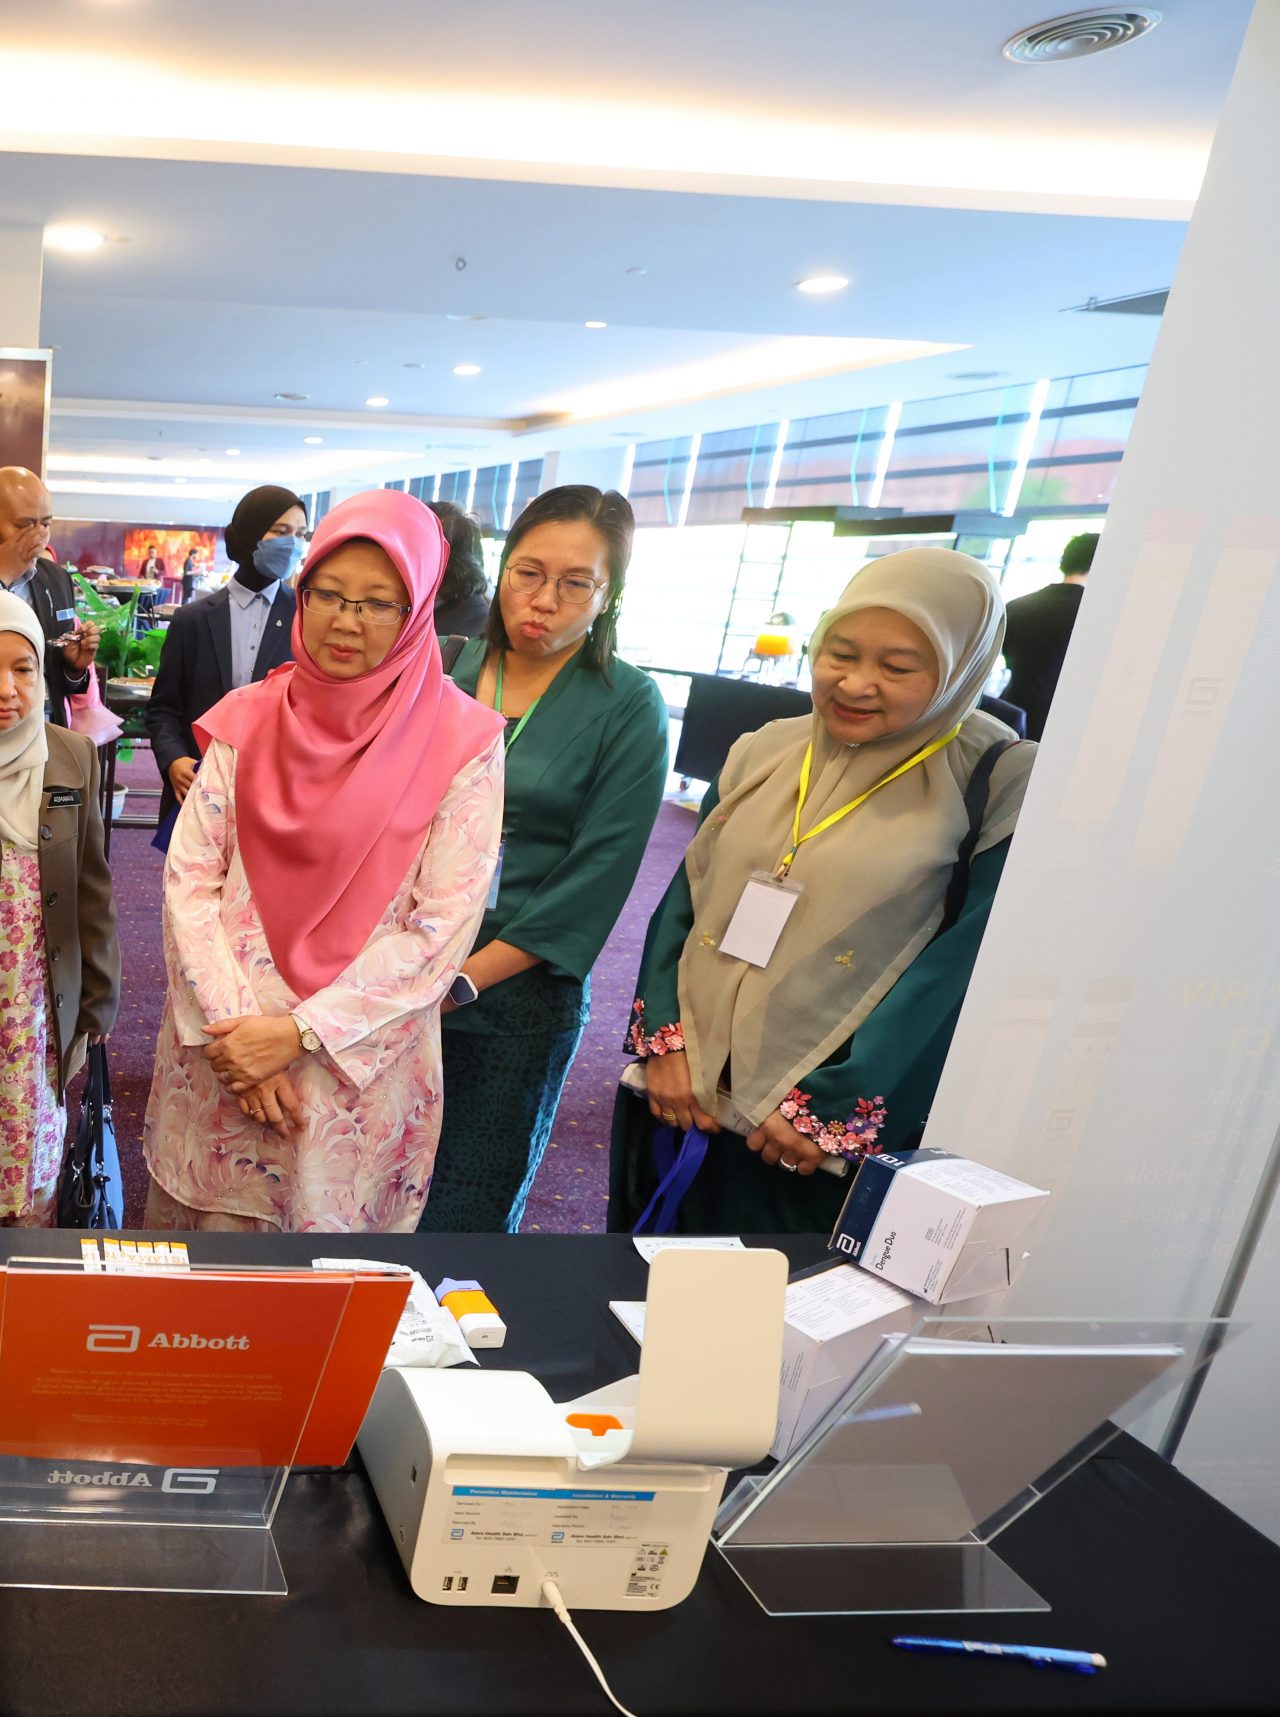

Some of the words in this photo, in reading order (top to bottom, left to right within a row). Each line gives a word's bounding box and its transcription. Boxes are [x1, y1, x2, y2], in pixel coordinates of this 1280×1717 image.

[875, 1245, 891, 1270] Dengue
[884, 1231, 896, 1246] Duo
[147, 1332, 250, 1351] Abbott
